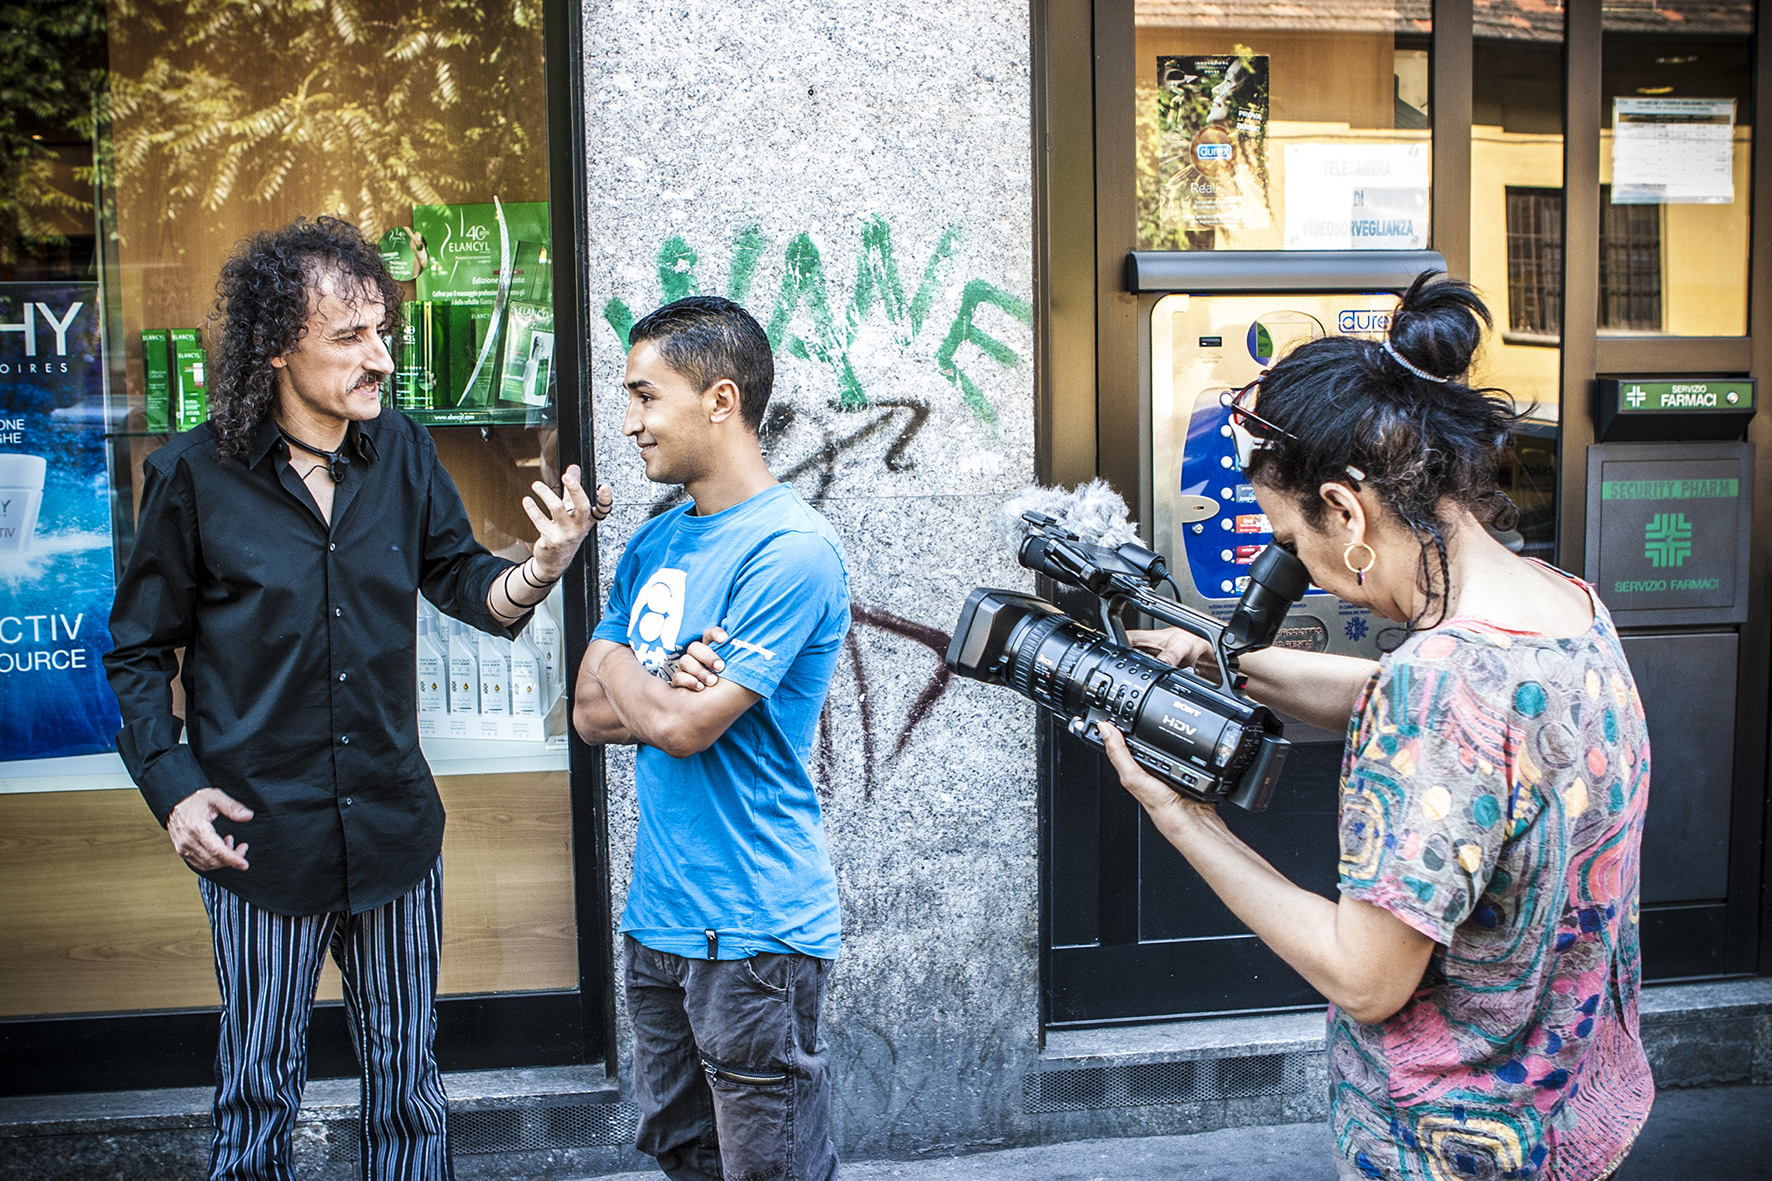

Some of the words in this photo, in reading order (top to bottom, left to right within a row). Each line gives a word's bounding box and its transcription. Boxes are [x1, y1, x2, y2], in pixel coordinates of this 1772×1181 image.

[1200, 145, 1229, 157] durex
[1322, 161, 1392, 177] TELECAMERA
[1353, 190, 1364, 206] DI
[1302, 219, 1414, 237] VIDEOSORVEGLIANZA
[448, 242, 491, 253] ELANCYL
[472, 276, 499, 285] Edizione
[518, 306, 550, 319] ELANCYL
[1342, 310, 1391, 331] dure
[0, 363, 68, 373] OIRES
[1671, 384, 1707, 393] SERVIZIO
[1661, 393, 1717, 407] FARMACI
[433, 413, 475, 422] www.elancyl.com
[1610, 481, 1675, 500] SECURITY
[1681, 479, 1730, 498] PHARM
[1614, 580, 1667, 593] SERVIZIO
[1670, 579, 1720, 590] FARMACI
[0, 613, 83, 644] CTIV
[0, 649, 86, 673] OURCE
[1172, 700, 1202, 717] SONY
[1162, 714, 1197, 736] HDV
